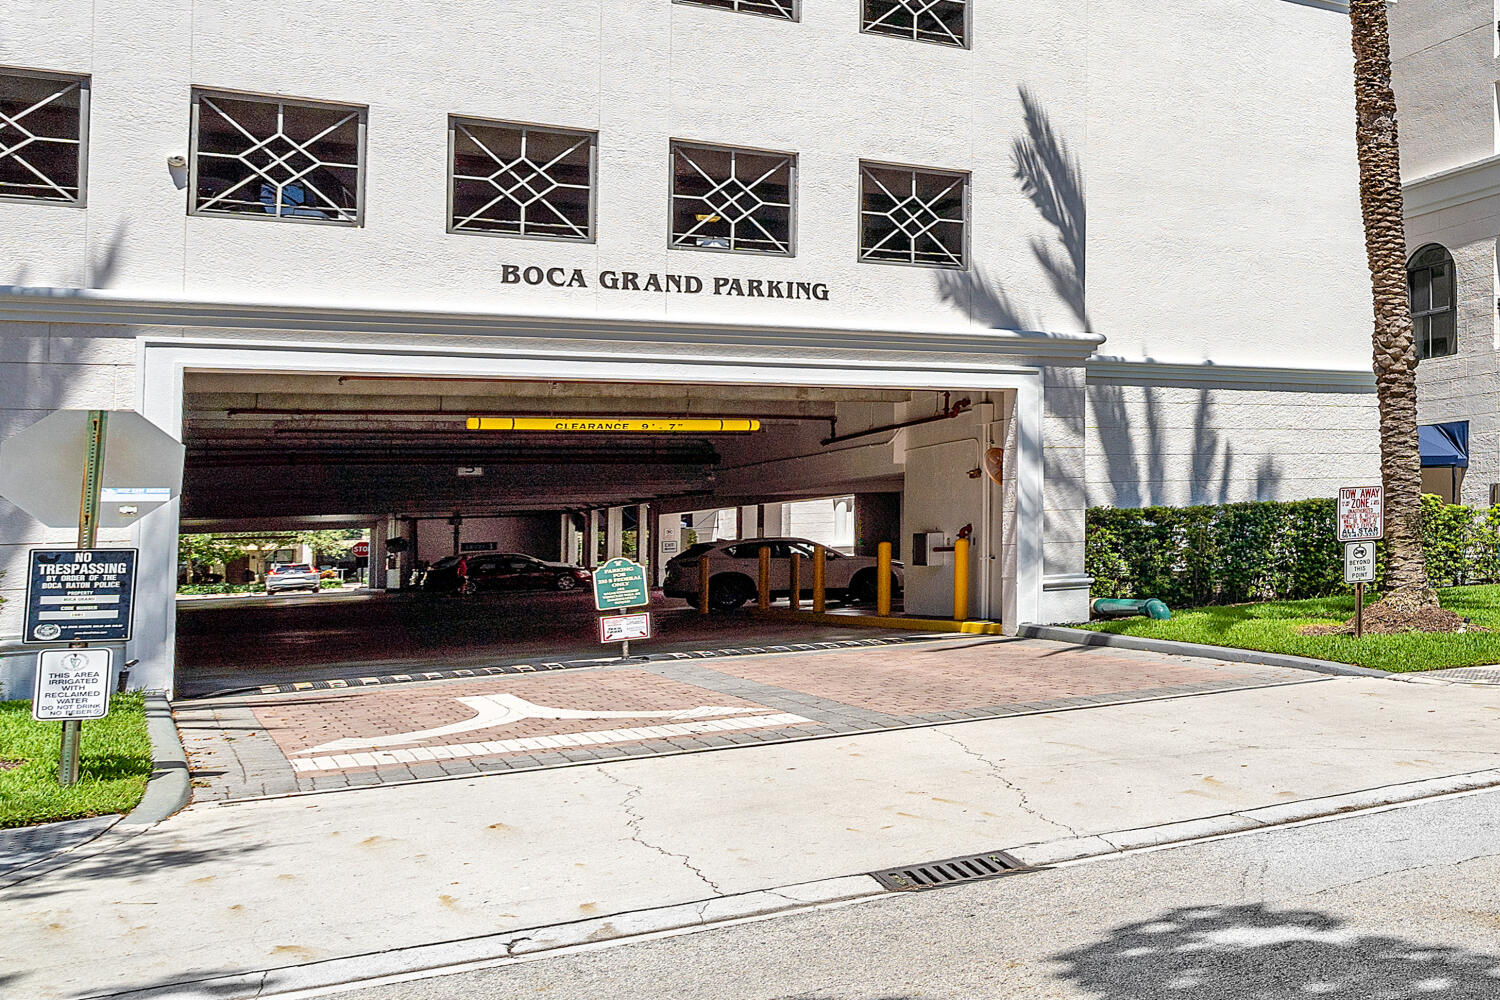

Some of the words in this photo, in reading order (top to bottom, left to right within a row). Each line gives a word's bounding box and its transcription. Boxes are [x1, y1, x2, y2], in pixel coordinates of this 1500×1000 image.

[500, 264, 588, 288] BOCA
[599, 270, 703, 294] GRAND
[713, 277, 830, 301] PARKING
[1342, 489, 1357, 499] TOW
[1360, 488, 1380, 498] AWAY
[1351, 499, 1370, 508] ZONE
[75, 553, 92, 563] NO
[39, 563, 127, 575] TRESPASSING
[48, 677, 99, 685] IRRIGATED
[44, 690, 101, 699] RECLAIMED
